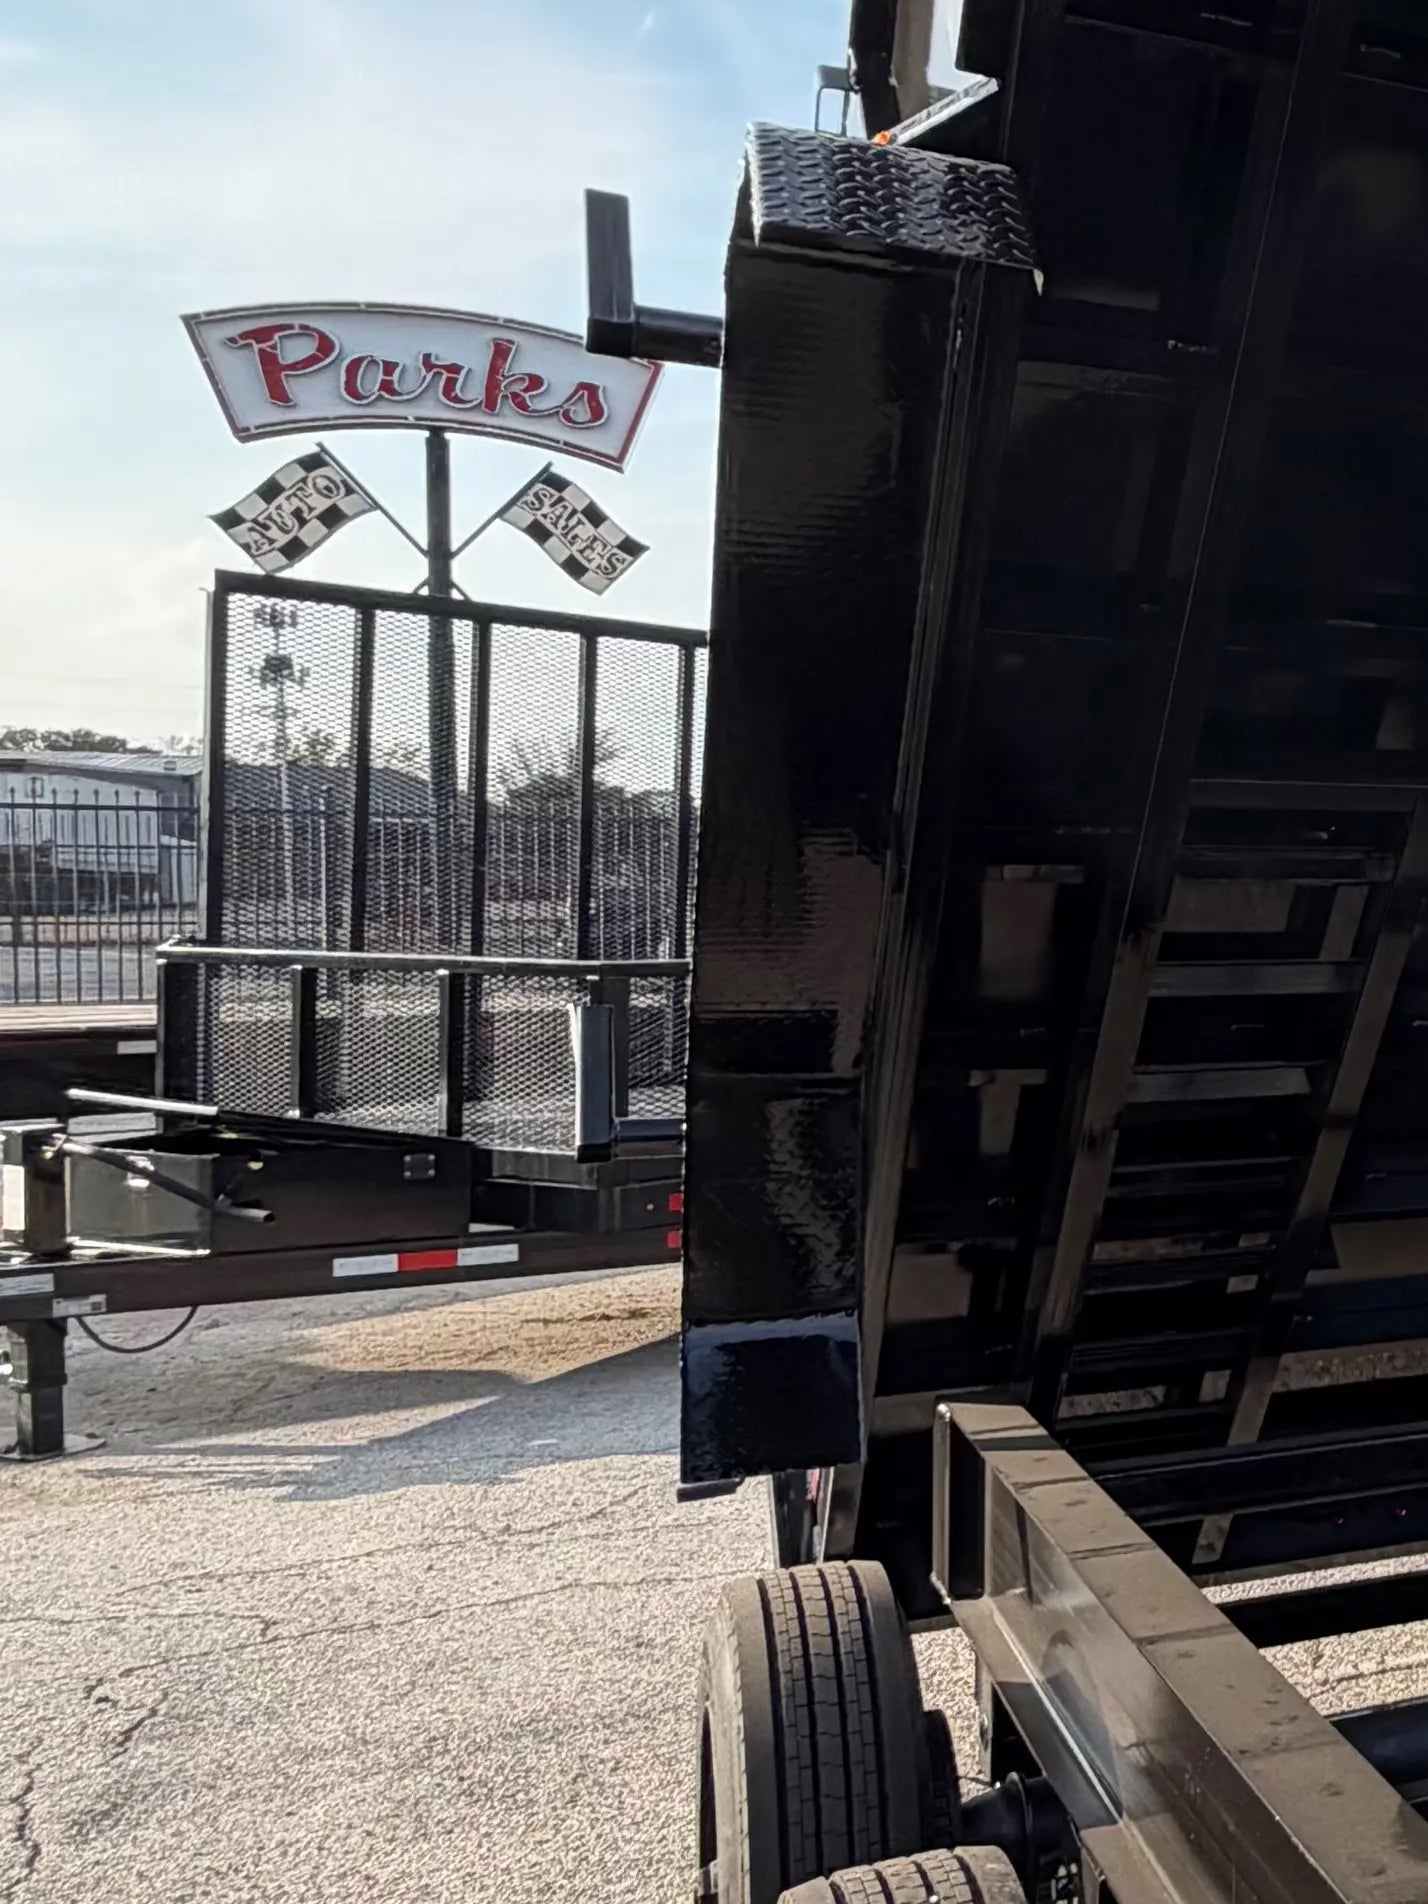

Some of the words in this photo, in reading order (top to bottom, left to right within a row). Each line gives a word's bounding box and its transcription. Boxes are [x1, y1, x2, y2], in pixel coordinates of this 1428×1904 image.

[225, 323, 608, 428] Parks
[248, 471, 344, 556] AUTO
[521, 486, 629, 578] SALES
